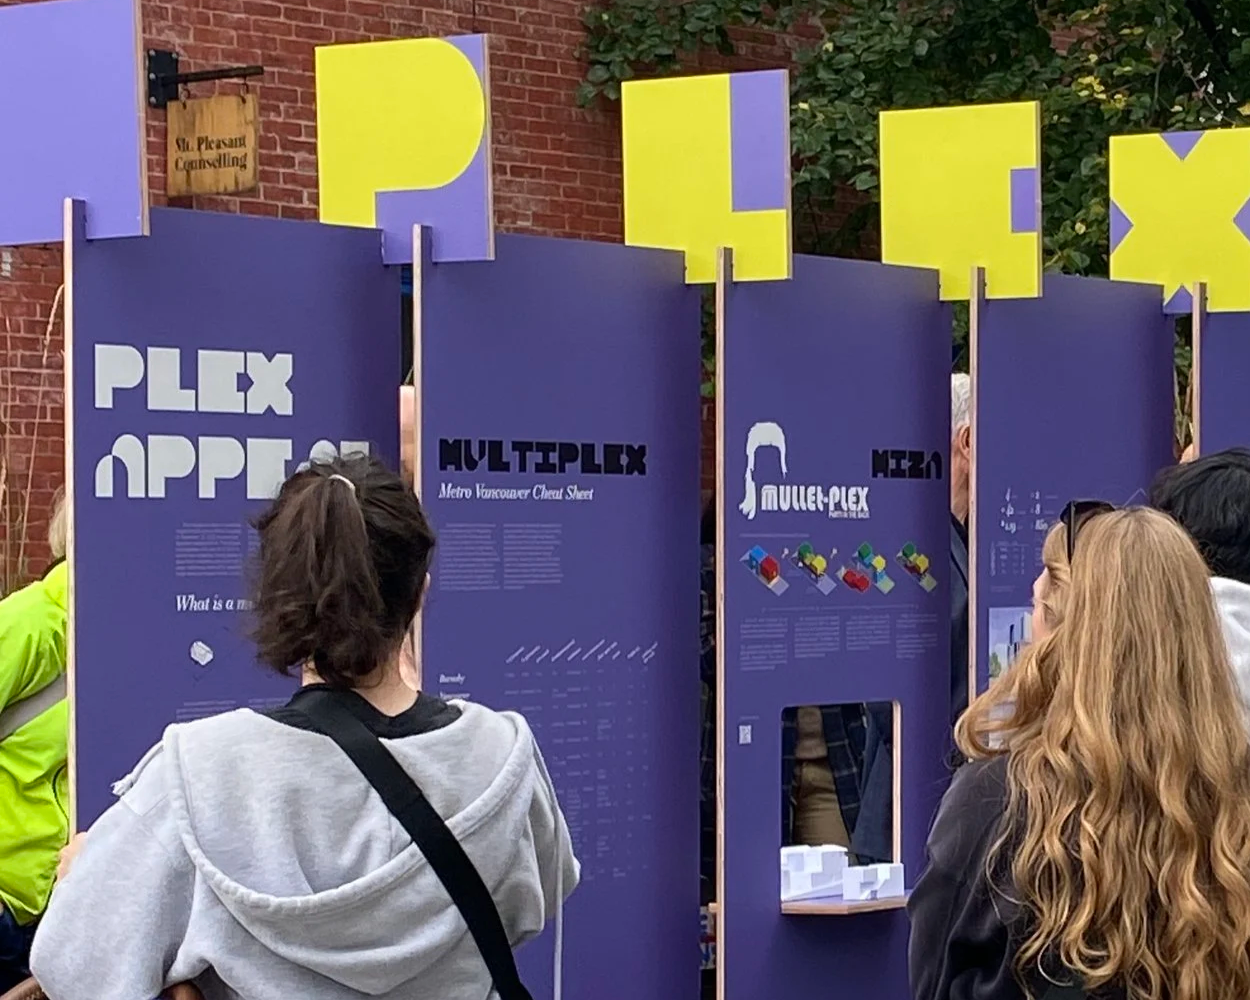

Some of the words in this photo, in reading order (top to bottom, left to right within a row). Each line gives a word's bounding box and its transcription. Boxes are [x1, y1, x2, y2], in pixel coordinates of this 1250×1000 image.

[197, 135, 246, 151] Pleasant
[175, 153, 247, 171] Counselling
[94, 343, 293, 415] PLEX
[439, 438, 646, 475] MULTIPLEX
[95, 434, 370, 500] APPE
[439, 482, 472, 499] Metro
[475, 483, 531, 500] Vancouver
[532, 484, 563, 500] Cheat
[565, 484, 594, 500] Sheet
[176, 594, 210, 611] What
[213, 594, 222, 611] is
[225, 599, 234, 610] a
